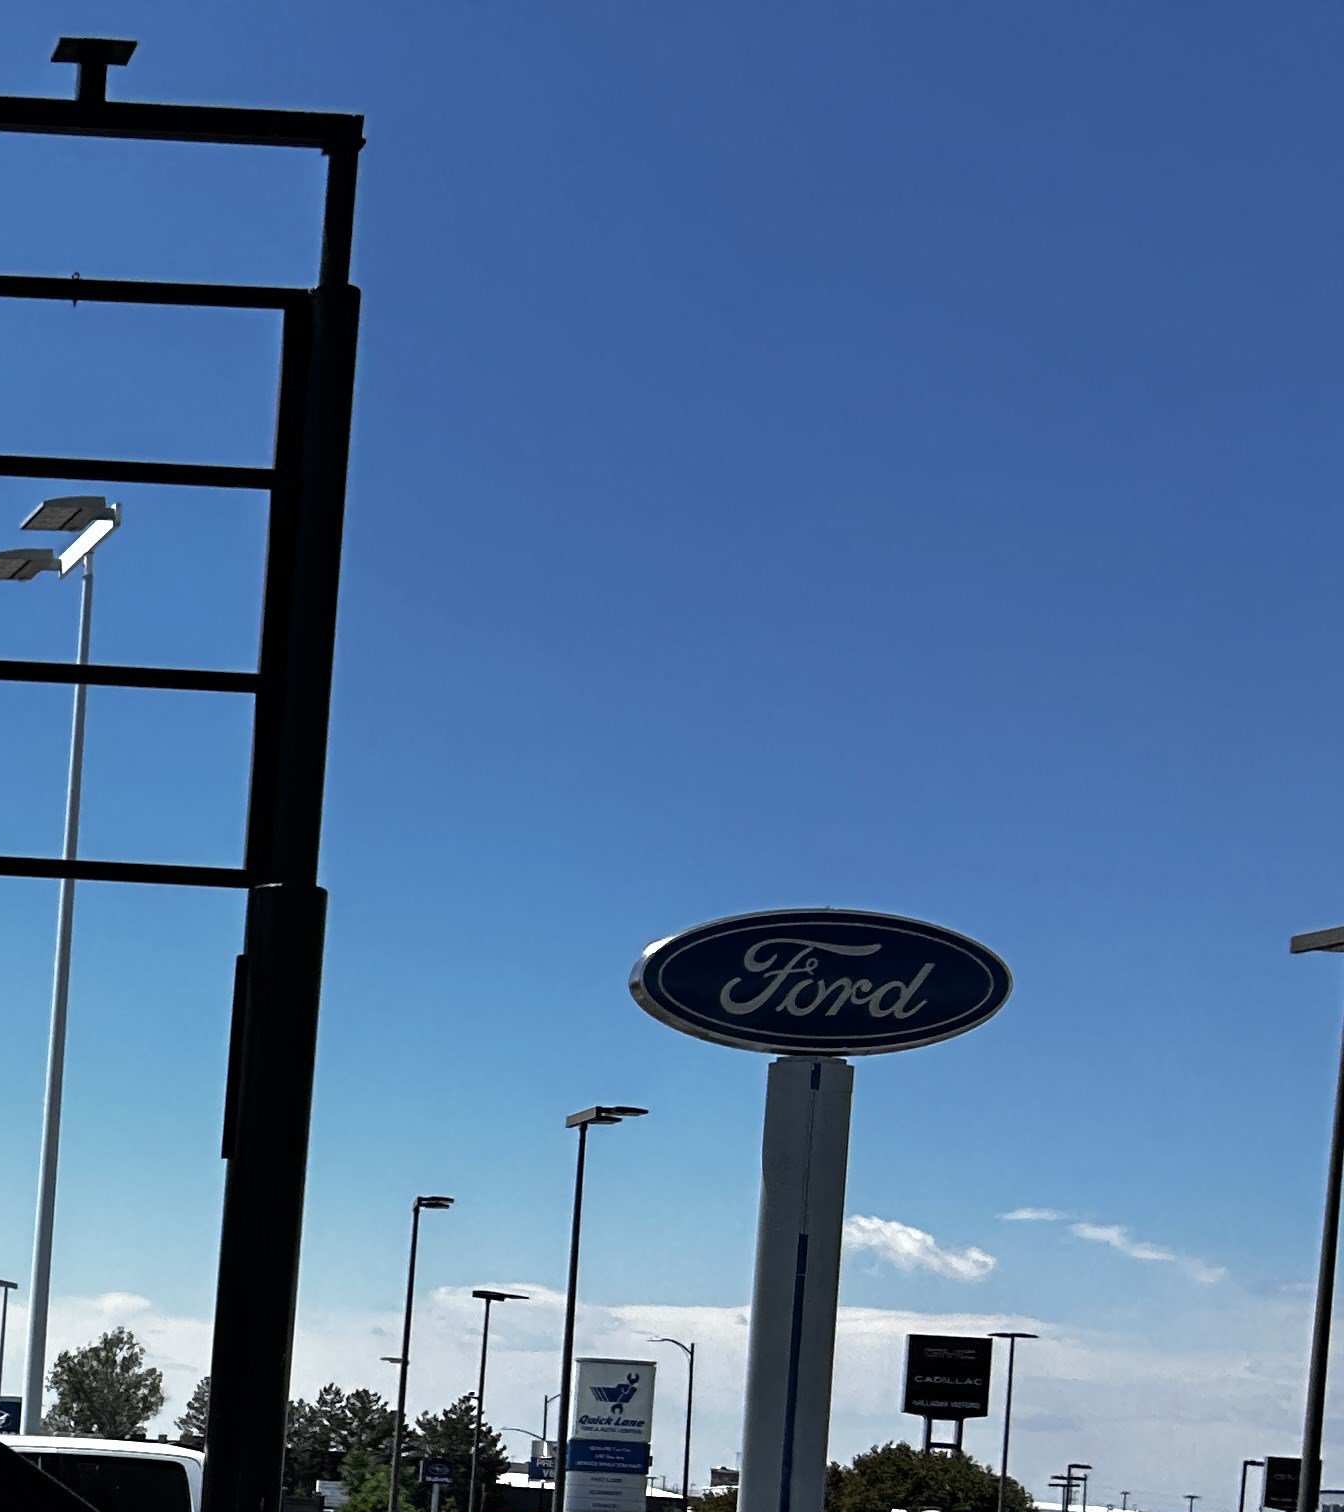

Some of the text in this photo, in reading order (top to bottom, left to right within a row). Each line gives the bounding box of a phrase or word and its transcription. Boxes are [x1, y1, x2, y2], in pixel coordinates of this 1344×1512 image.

[719, 937, 936, 1020] Ford
[914, 1375, 983, 1386] CADILLAC
[578, 1414, 646, 1428] Quick Lane
